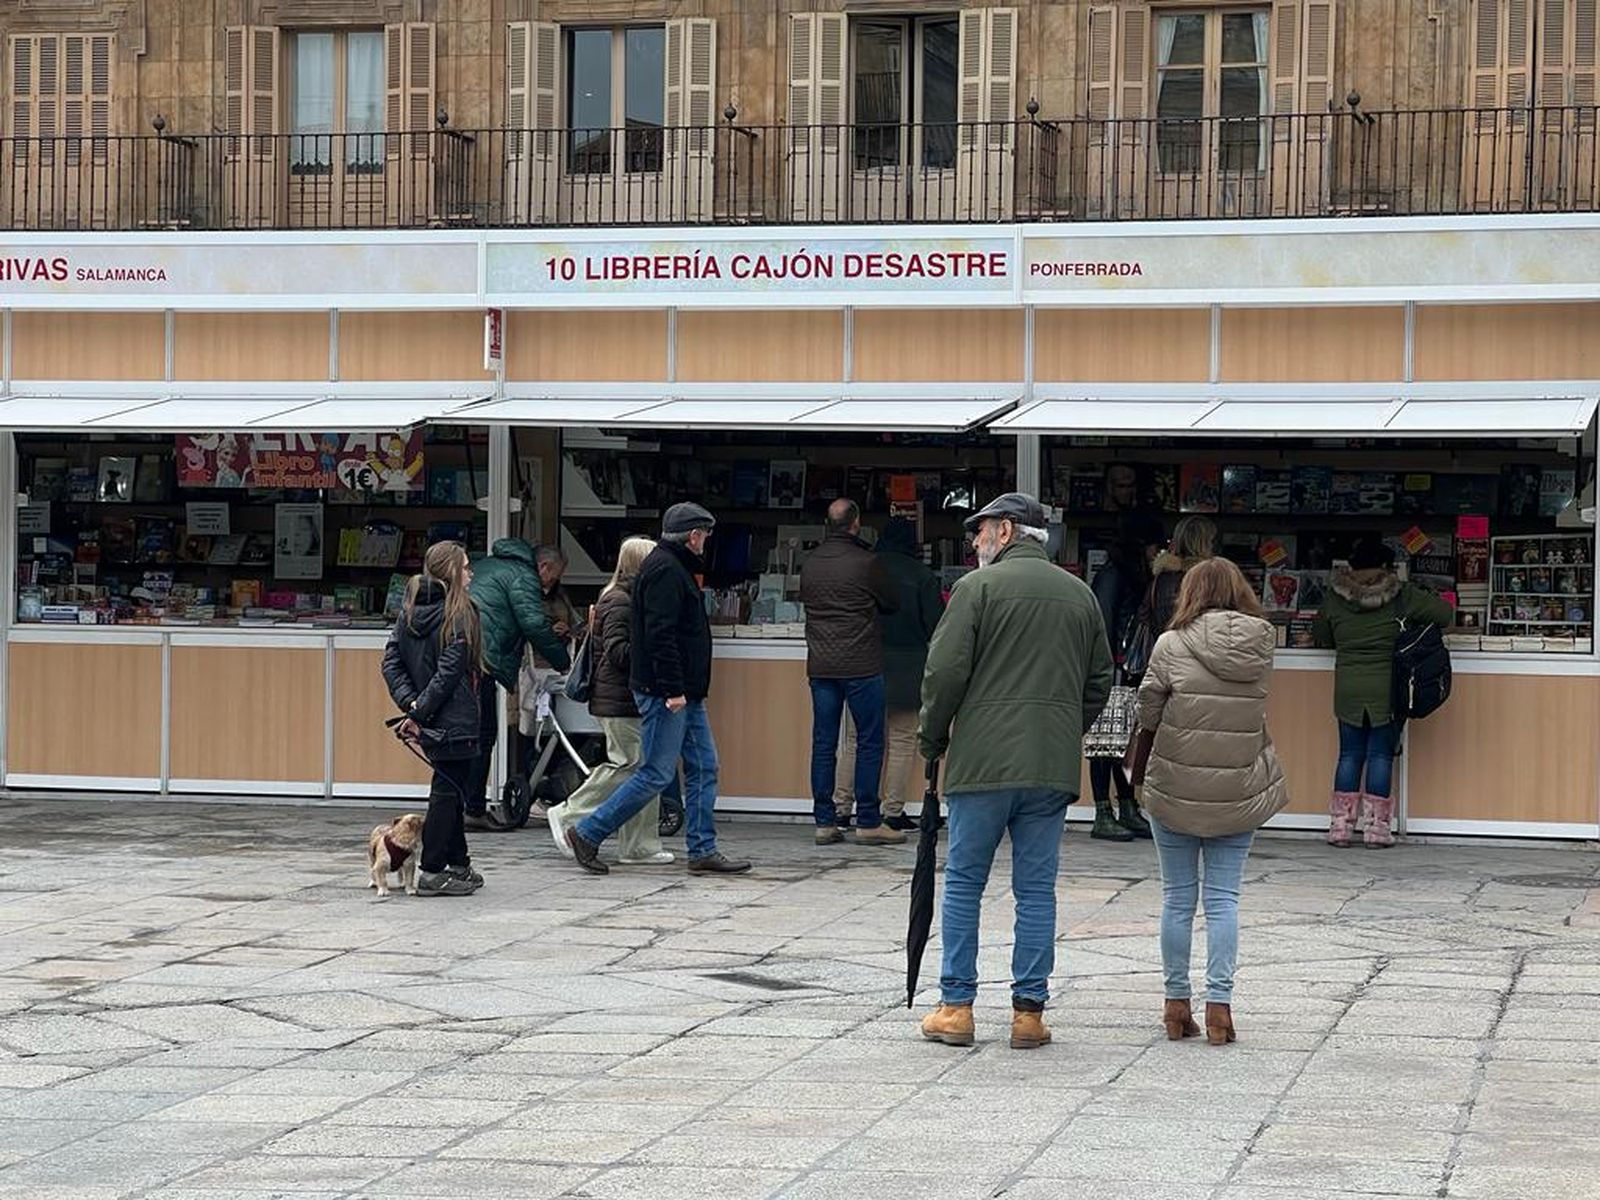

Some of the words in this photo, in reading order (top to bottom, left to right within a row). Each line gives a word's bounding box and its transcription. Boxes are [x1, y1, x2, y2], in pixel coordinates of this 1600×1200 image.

[0, 258, 69, 281] IVAS
[76, 268, 167, 281] SALAMANCA
[545, 257, 575, 281] 10
[585, 250, 721, 280] LIBRERÍA
[730, 248, 834, 279] CAJÓN
[843, 252, 1007, 278] DESASTRE
[1030, 262, 1143, 277] PONFERRADA
[251, 452, 316, 471] Libro
